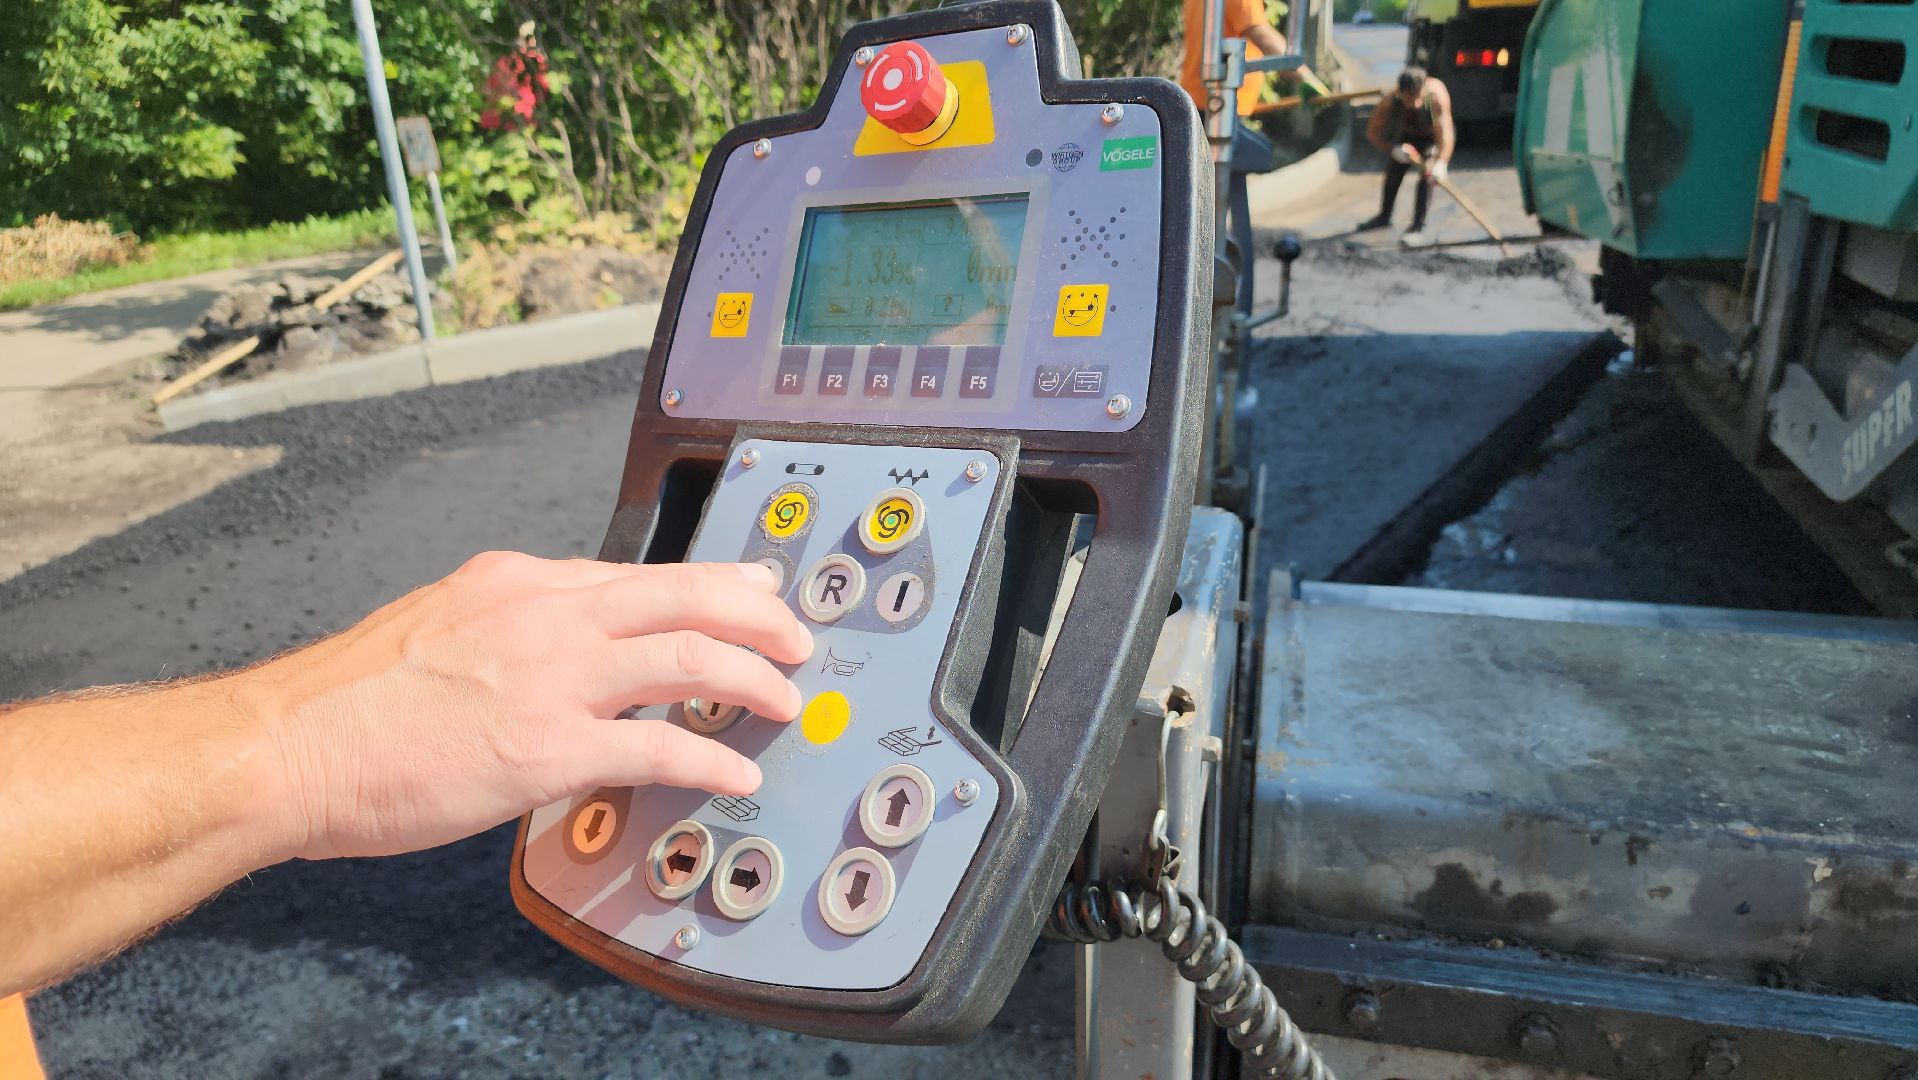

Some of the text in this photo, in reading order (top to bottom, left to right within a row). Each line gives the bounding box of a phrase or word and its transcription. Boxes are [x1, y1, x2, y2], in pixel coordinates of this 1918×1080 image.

[1051, 150, 1084, 159] WIRTGEN
[1103, 147, 1155, 163] VÖGELE
[782, 373, 987, 389] F1 F2 F3 F4 F5
[819, 574, 848, 605] R
